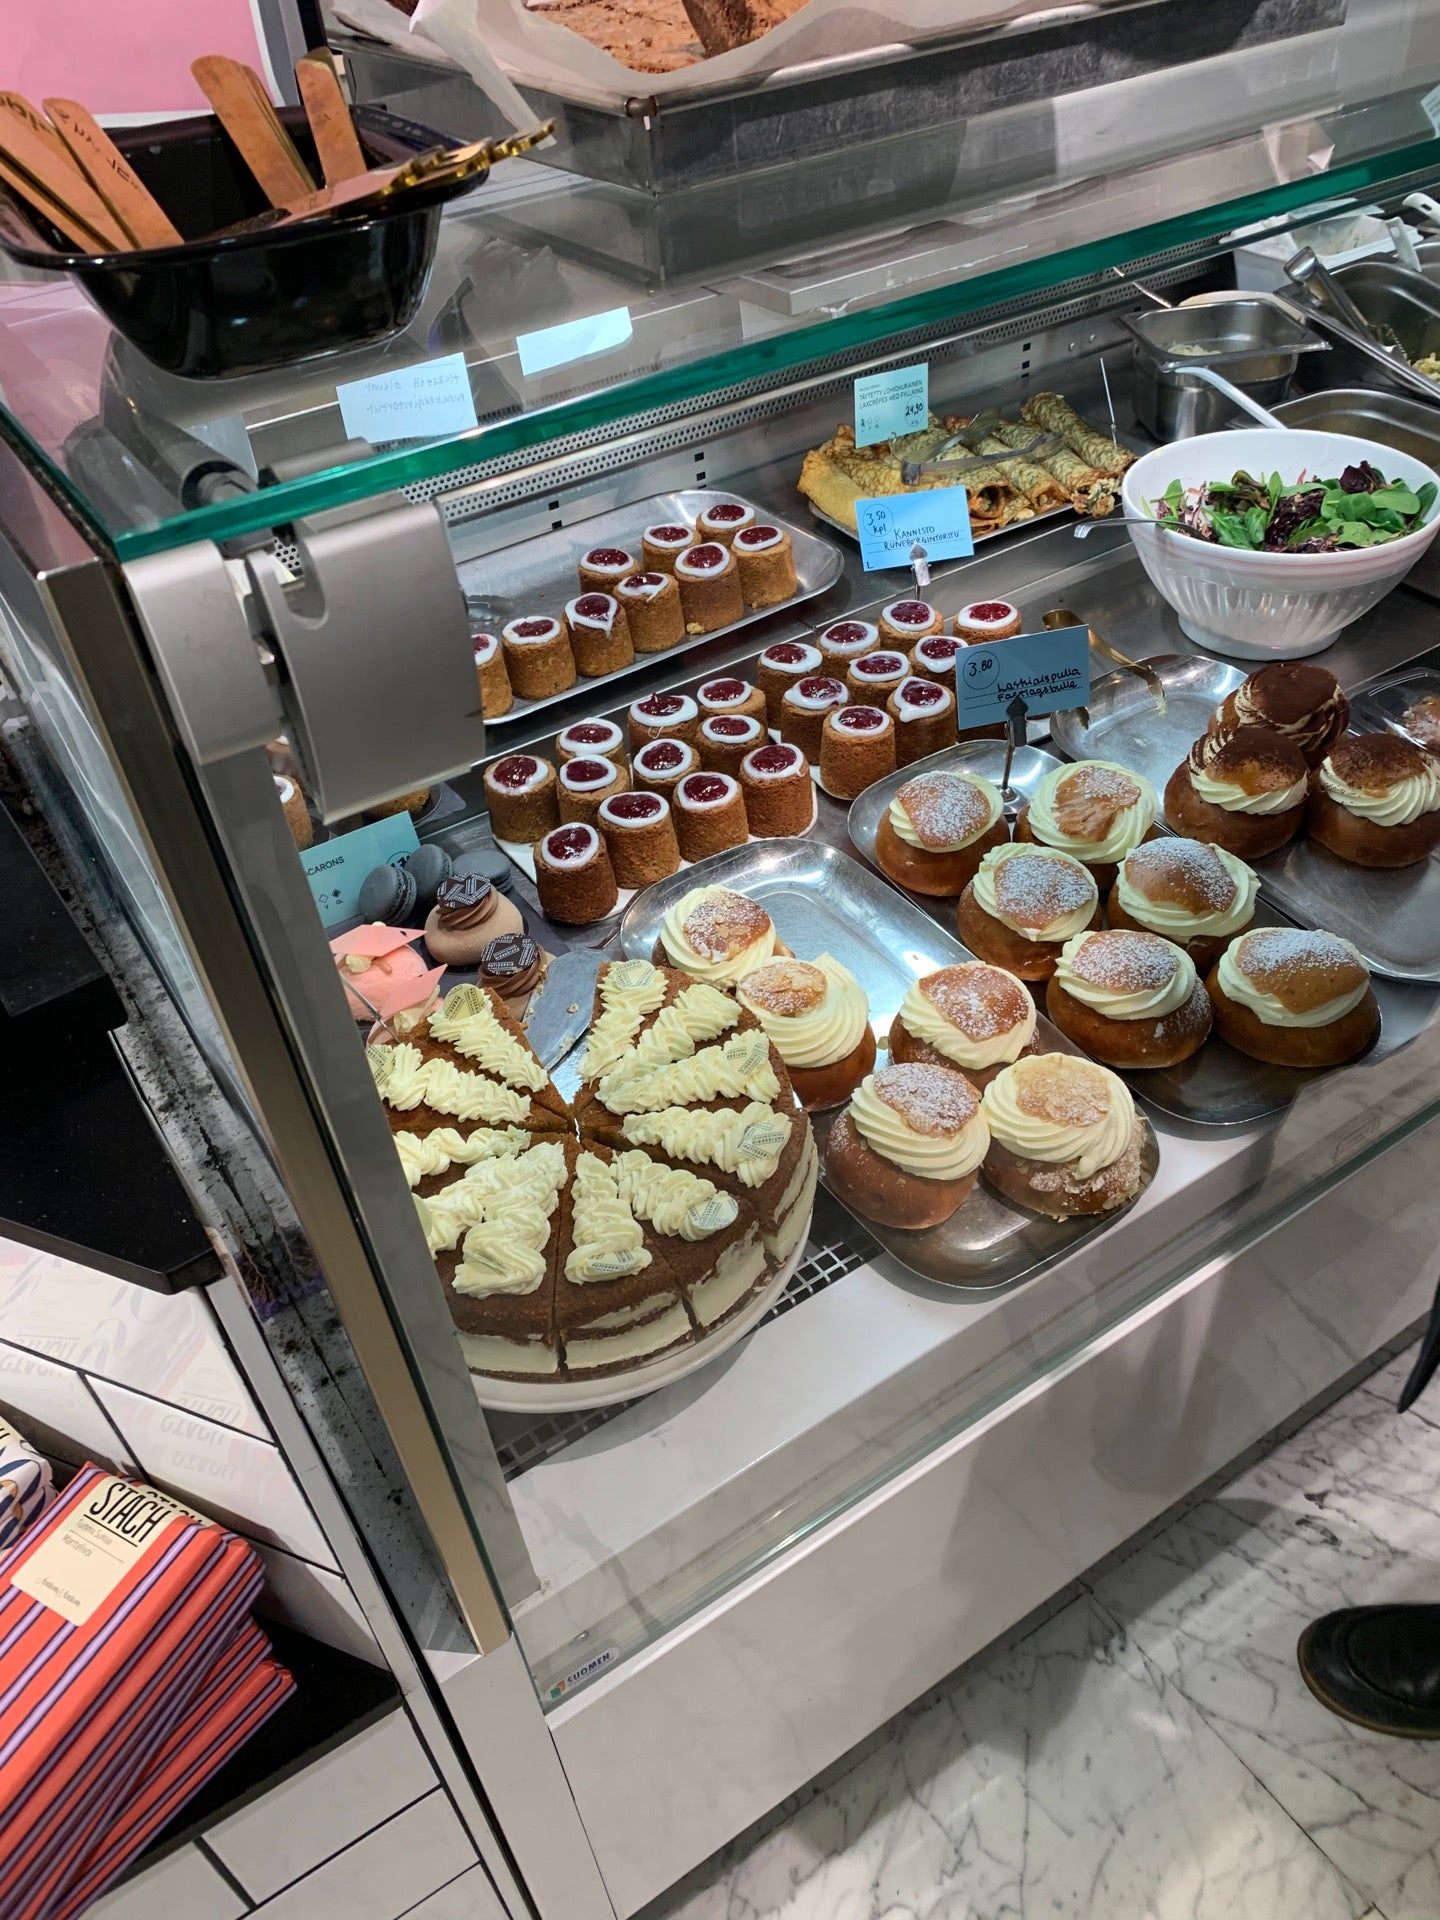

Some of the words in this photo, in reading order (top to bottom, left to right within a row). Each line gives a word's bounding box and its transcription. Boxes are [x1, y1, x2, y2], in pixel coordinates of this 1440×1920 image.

[893, 526, 935, 540] KANNISTO
[968, 659, 993, 677] 3.80
[89, 1482, 172, 1543] STACH
[567, 1652, 610, 1683] SUOMEN
